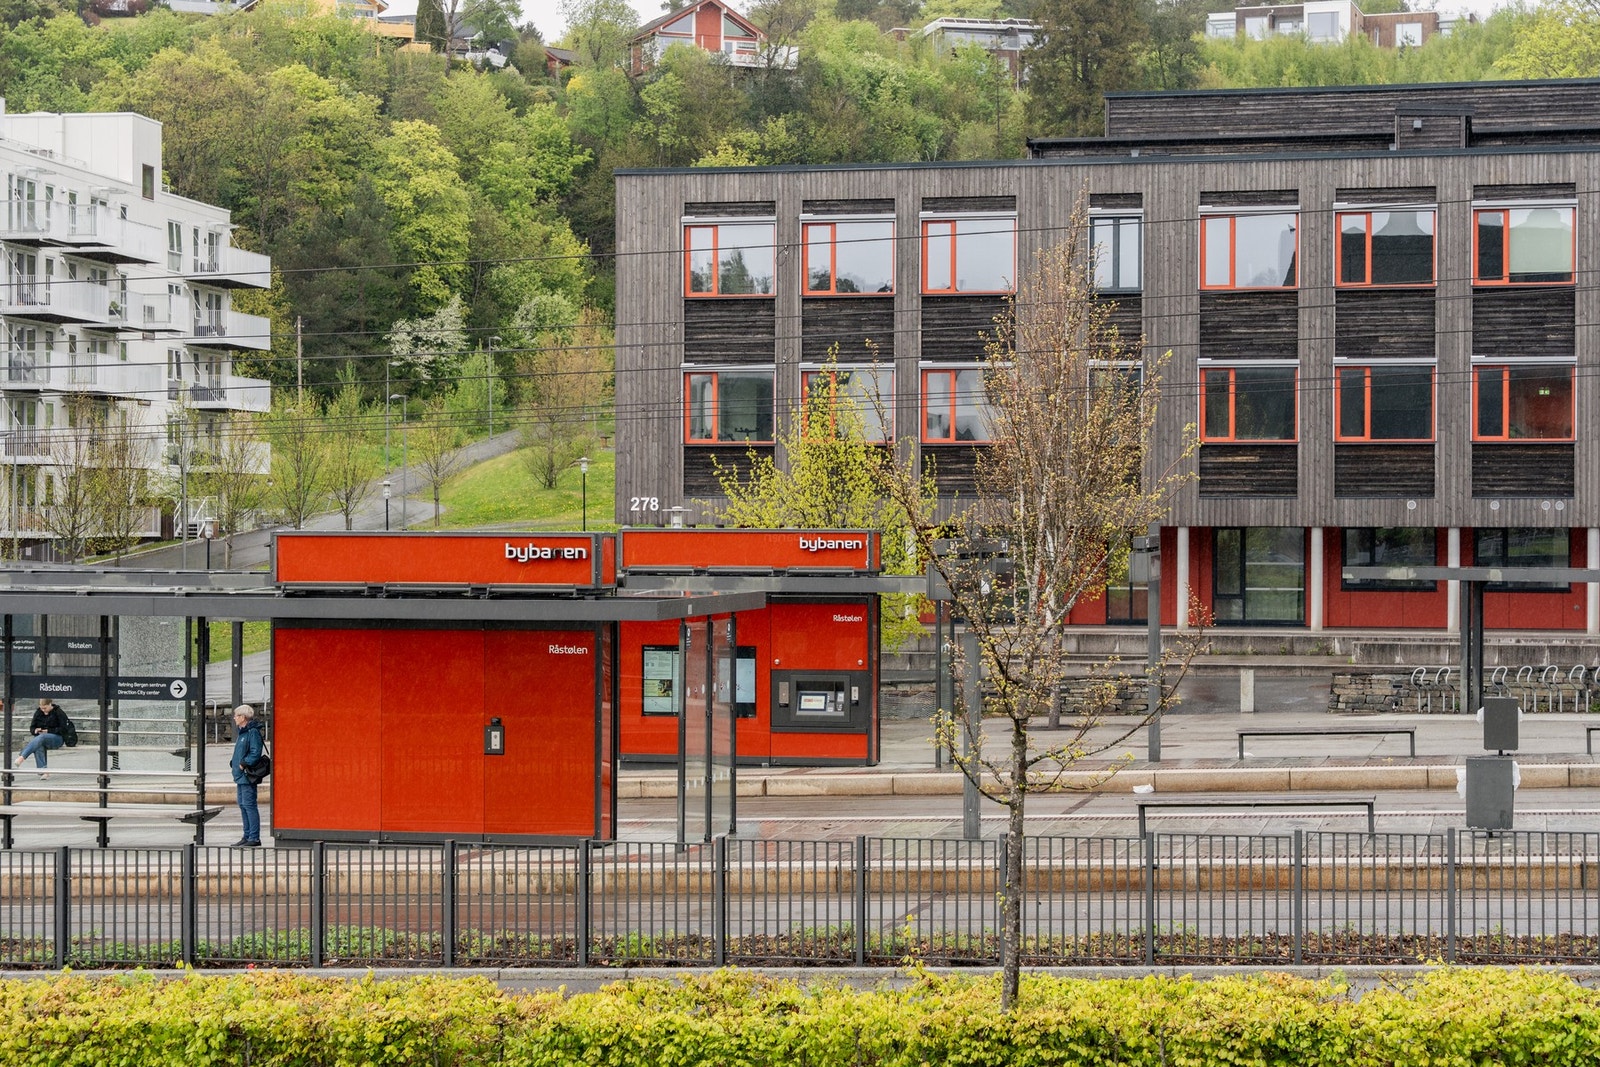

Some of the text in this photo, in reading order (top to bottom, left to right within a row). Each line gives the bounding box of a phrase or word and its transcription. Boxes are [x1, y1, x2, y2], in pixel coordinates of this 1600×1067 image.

[630, 497, 659, 511] 278
[799, 537, 863, 551] bybanen
[505, 543, 587, 562] bybanen
[833, 614, 862, 622] Råstølen
[548, 644, 588, 655] Råstølen
[39, 683, 72, 692] Råstølen
